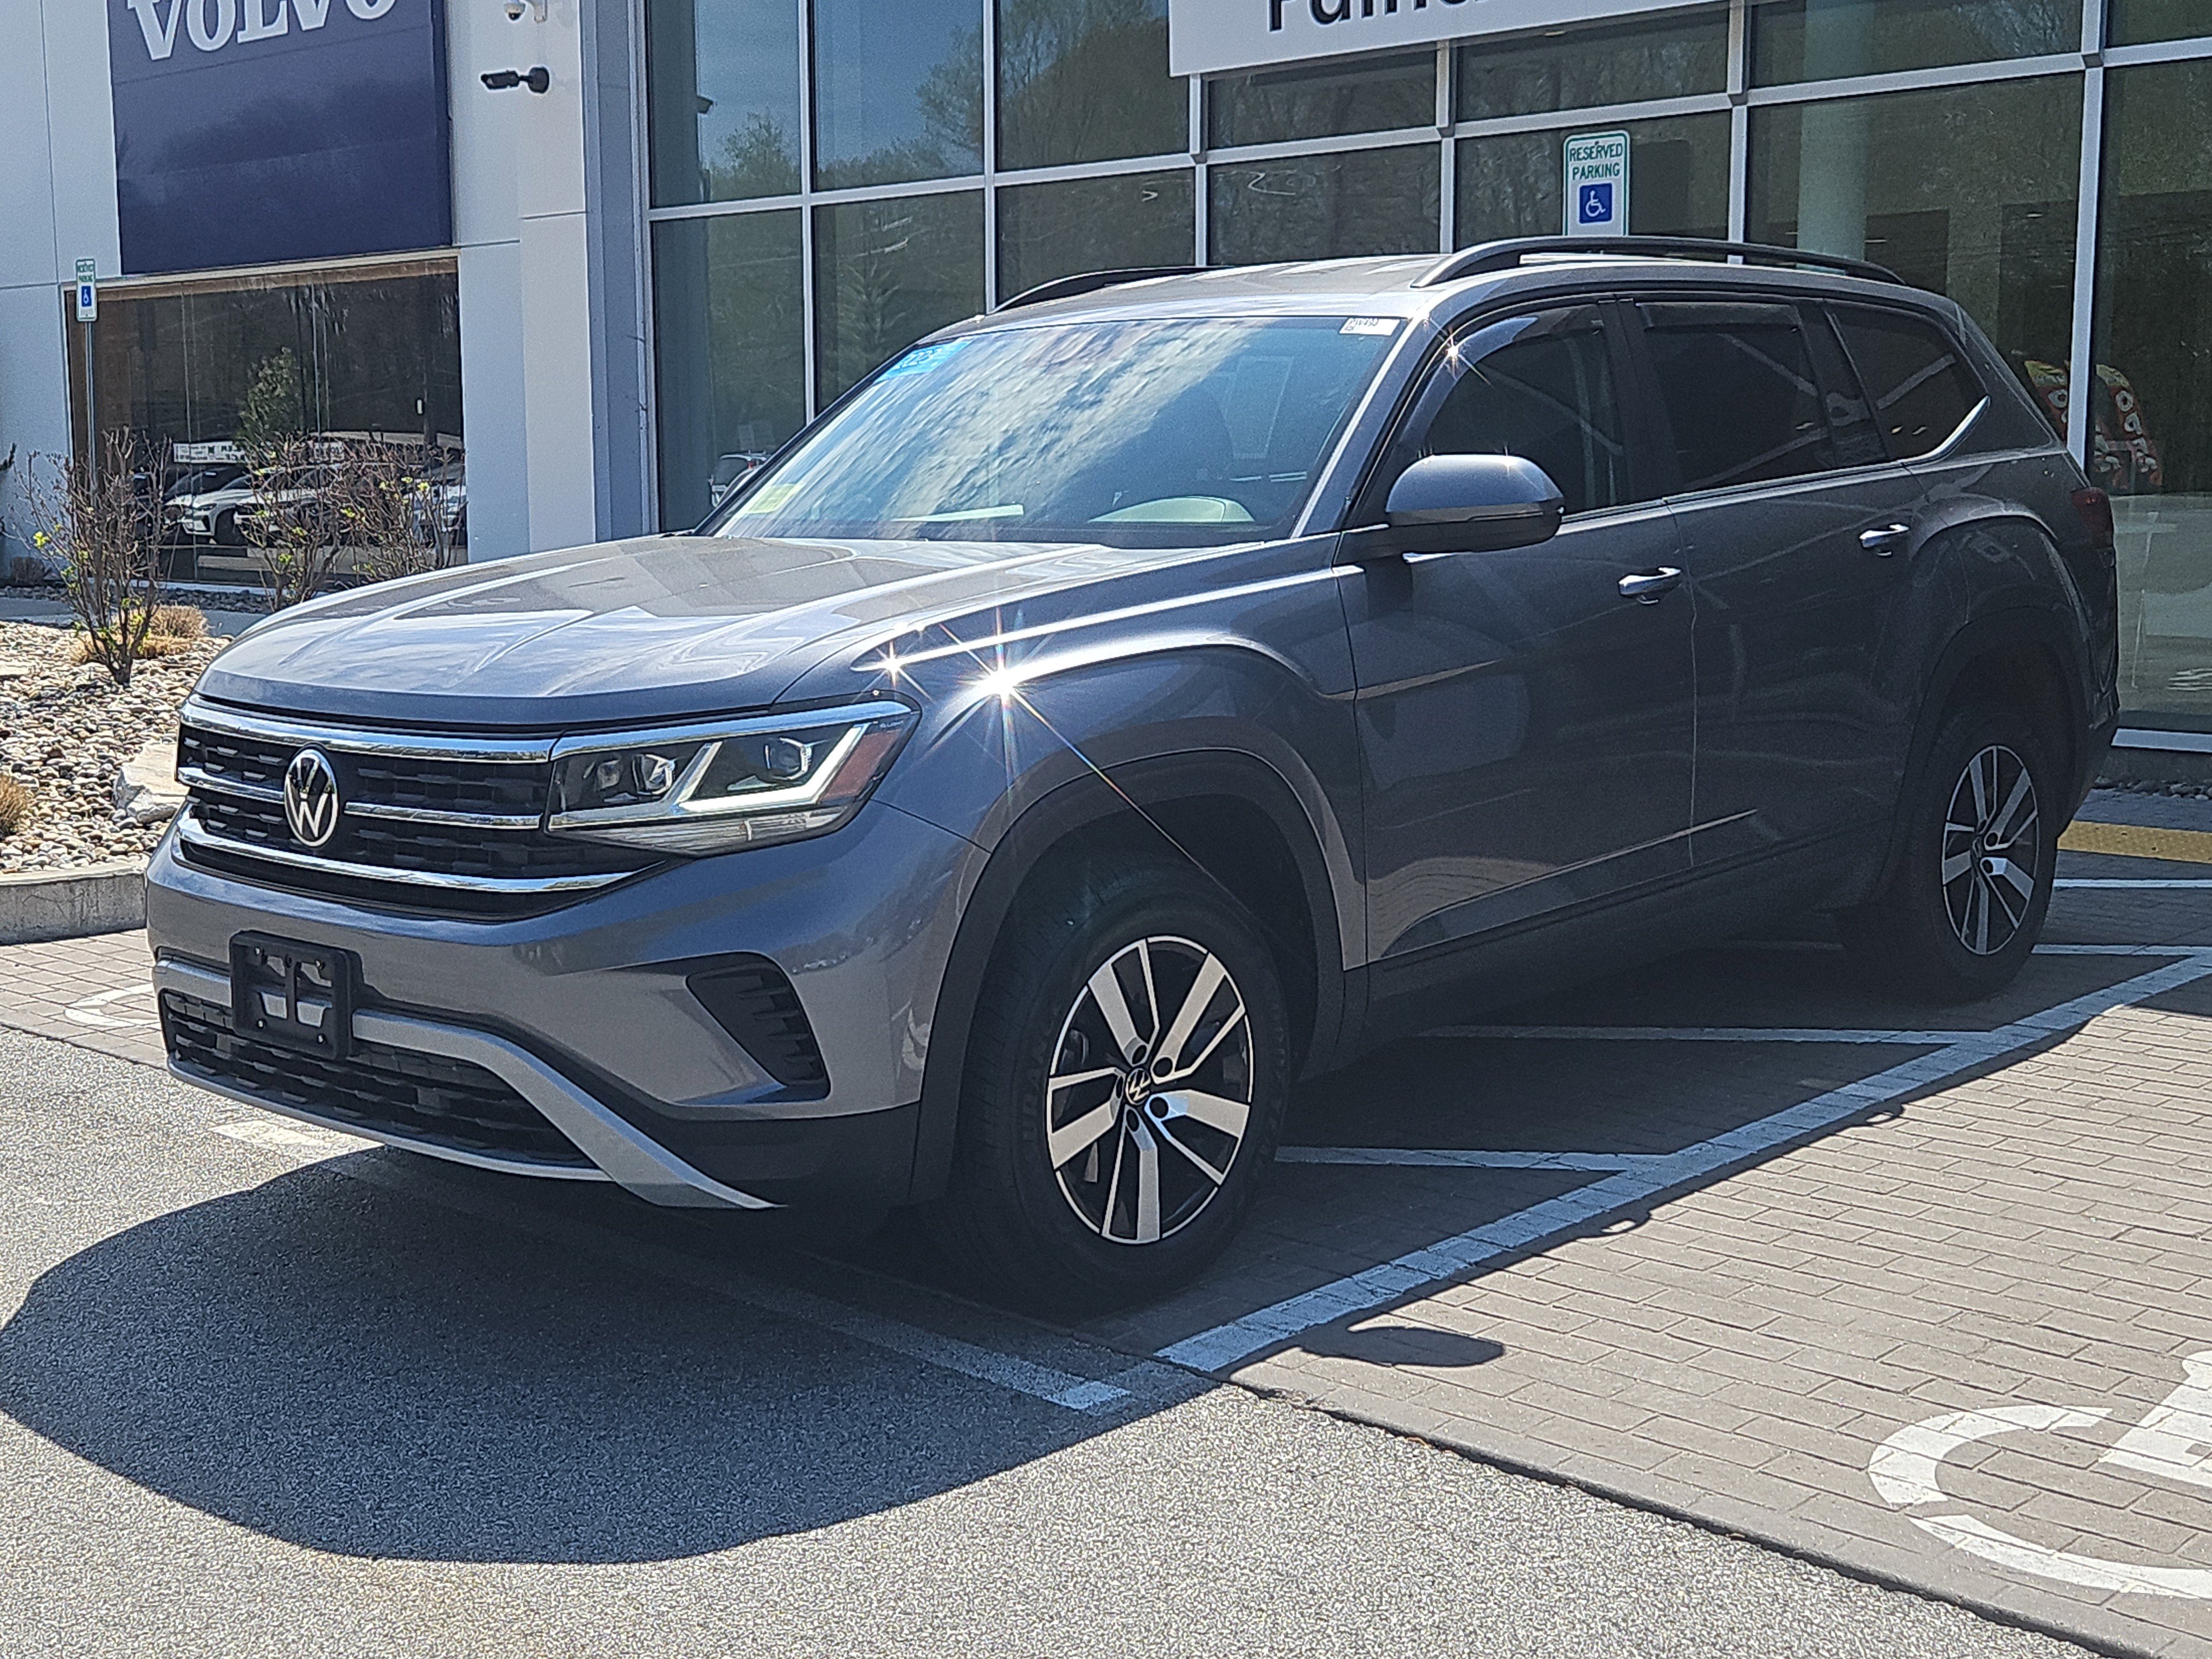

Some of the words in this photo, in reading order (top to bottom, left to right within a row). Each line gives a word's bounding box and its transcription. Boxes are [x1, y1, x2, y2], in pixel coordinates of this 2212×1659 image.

[1570, 143, 1623, 162] RESERVED
[1573, 163, 1620, 181] PARKING
[285, 750, 337, 846] VW
